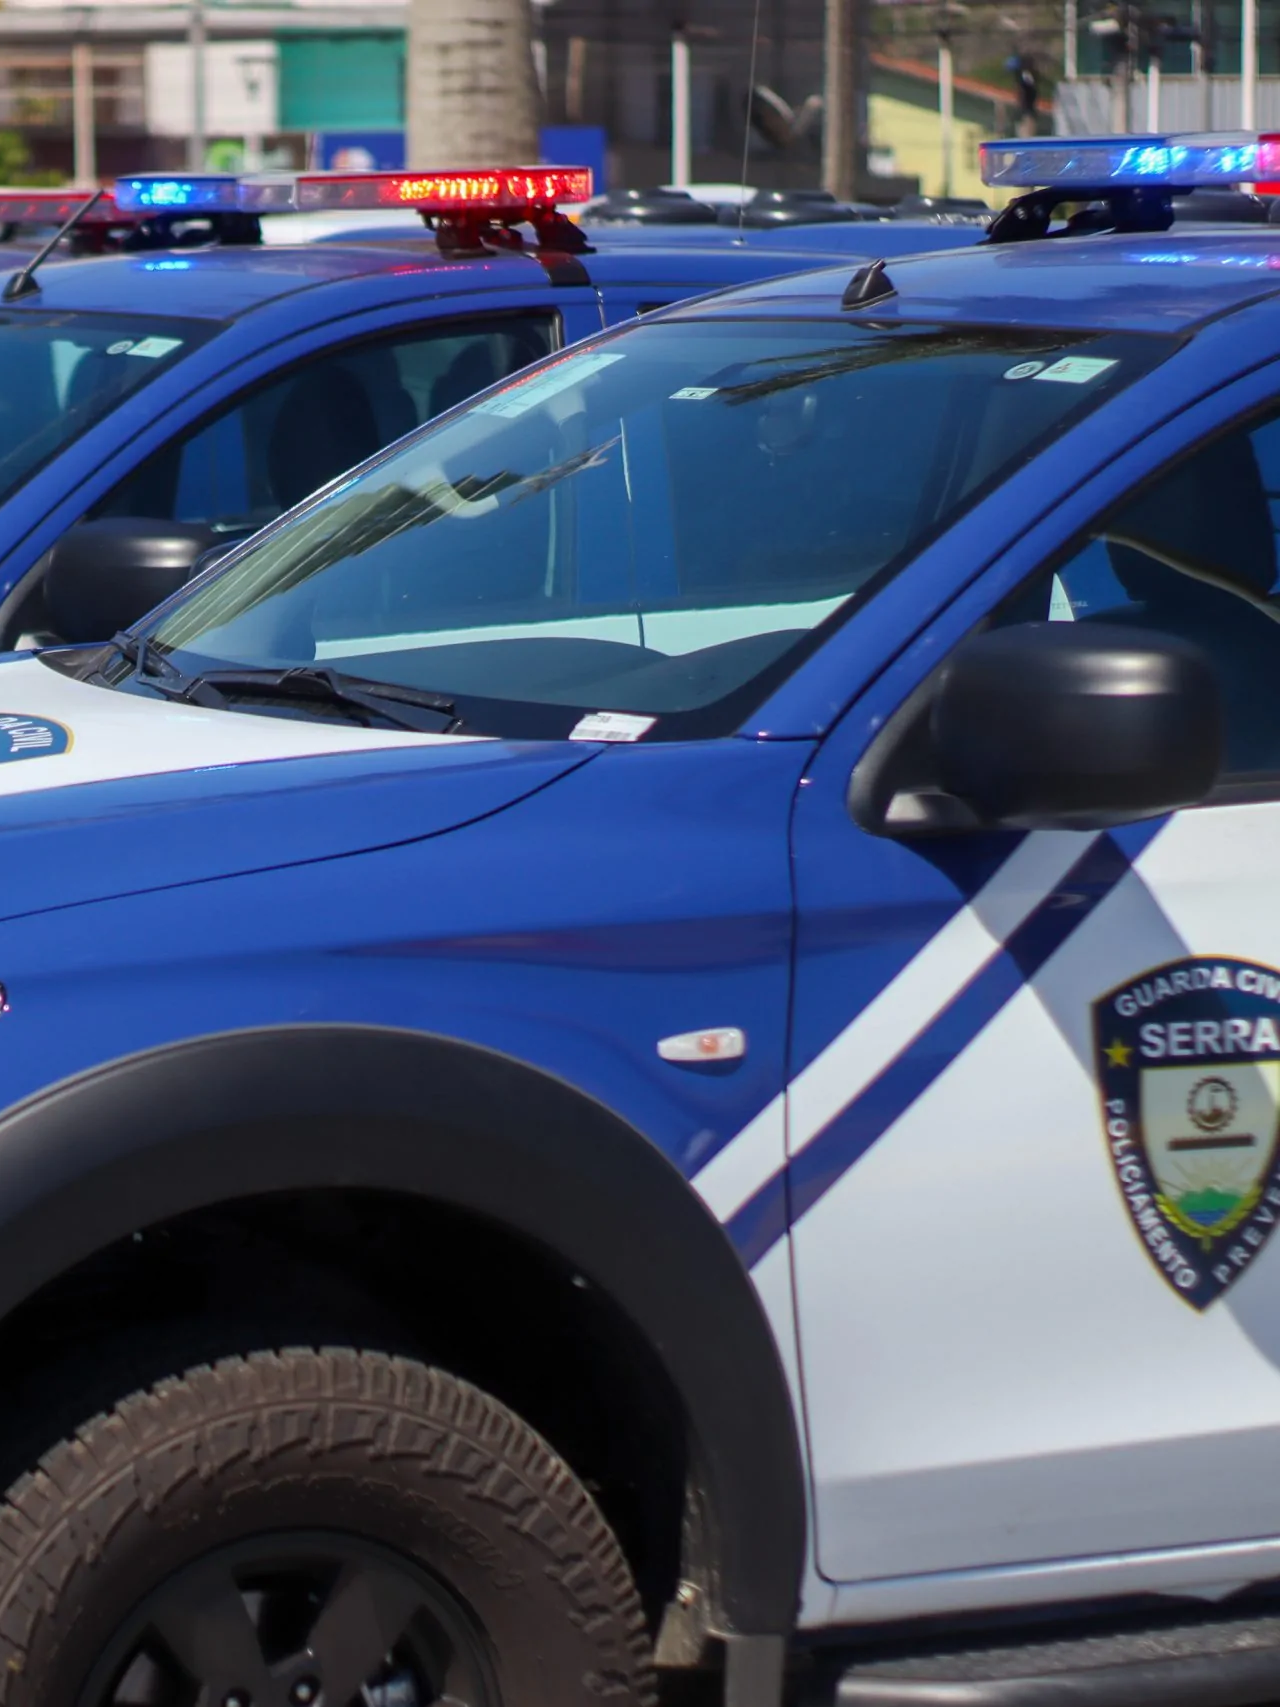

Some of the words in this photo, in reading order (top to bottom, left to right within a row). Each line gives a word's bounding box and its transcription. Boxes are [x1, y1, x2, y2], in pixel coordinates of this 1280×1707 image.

[8, 726, 54, 753] CIVIL
[1114, 965, 1233, 1016] GUARDA
[1139, 1016, 1280, 1058] SERRA
[1106, 1098, 1197, 1288] POLICIAMENTO
